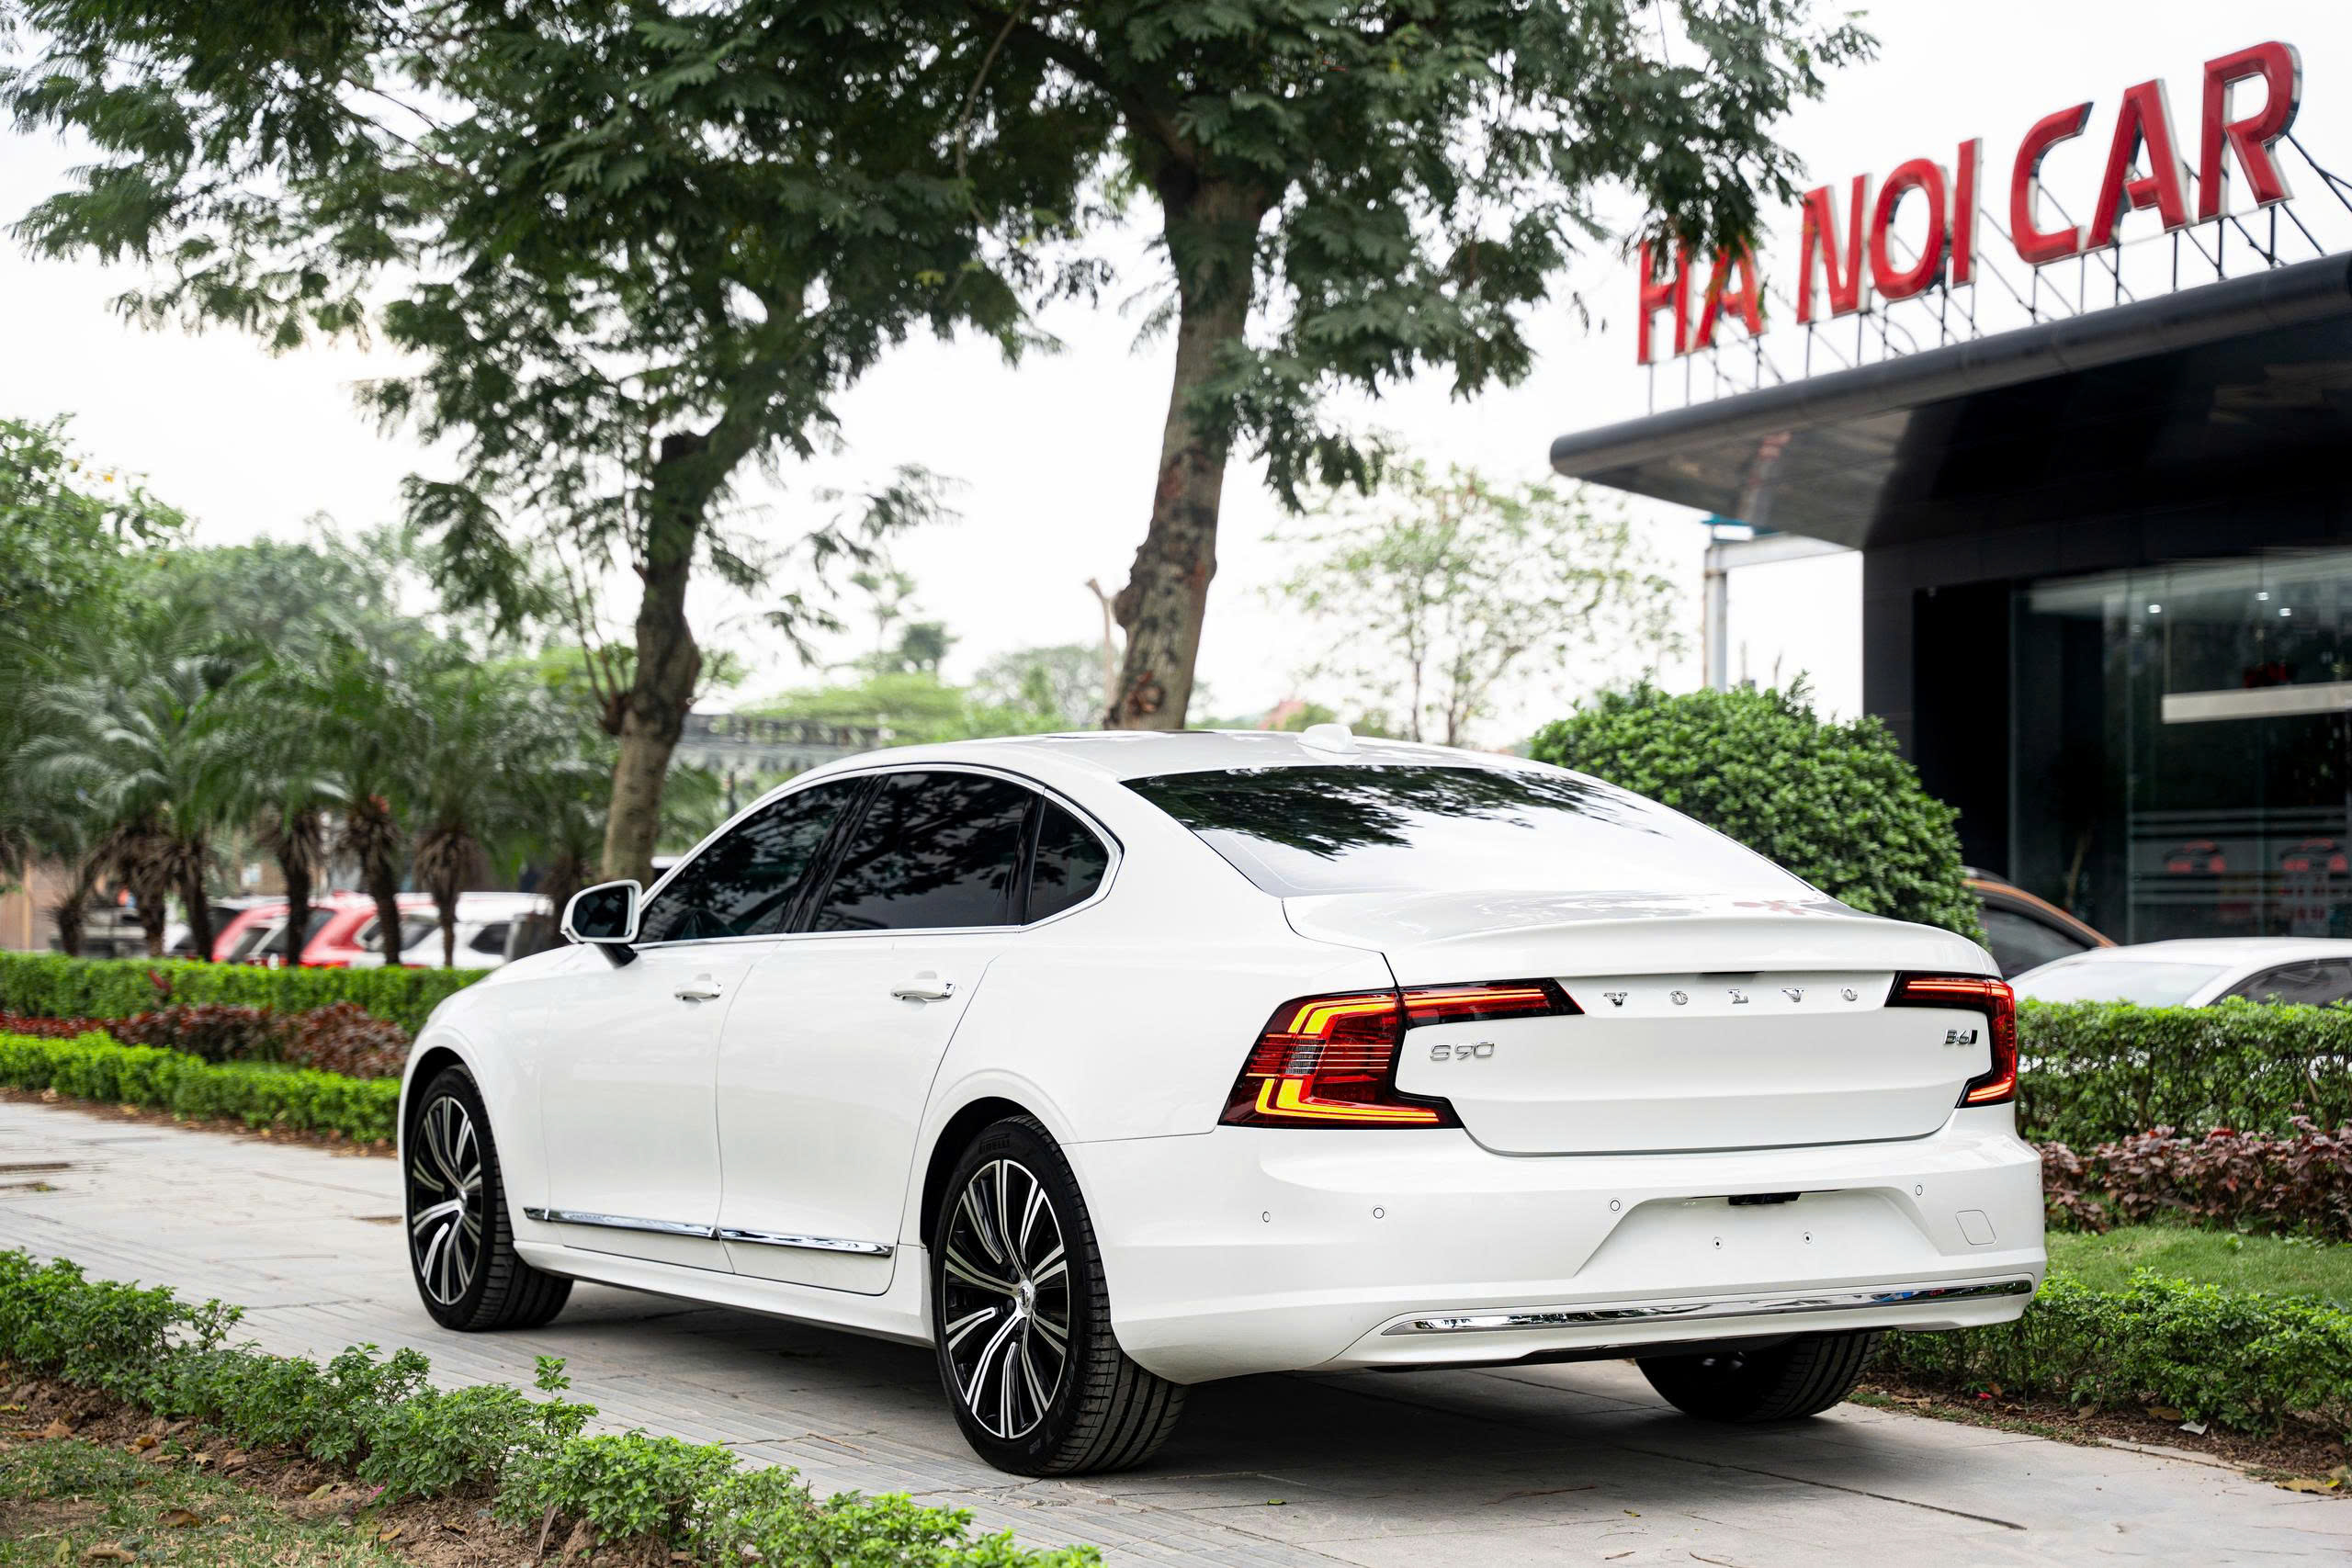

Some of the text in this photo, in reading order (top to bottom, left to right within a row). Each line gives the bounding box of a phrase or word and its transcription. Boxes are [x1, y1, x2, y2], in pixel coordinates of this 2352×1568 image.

[1637, 40, 2301, 365] HA NOI CAR
[1603, 987, 1859, 1008] VOLVO
[1430, 1042, 1495, 1062] S90
